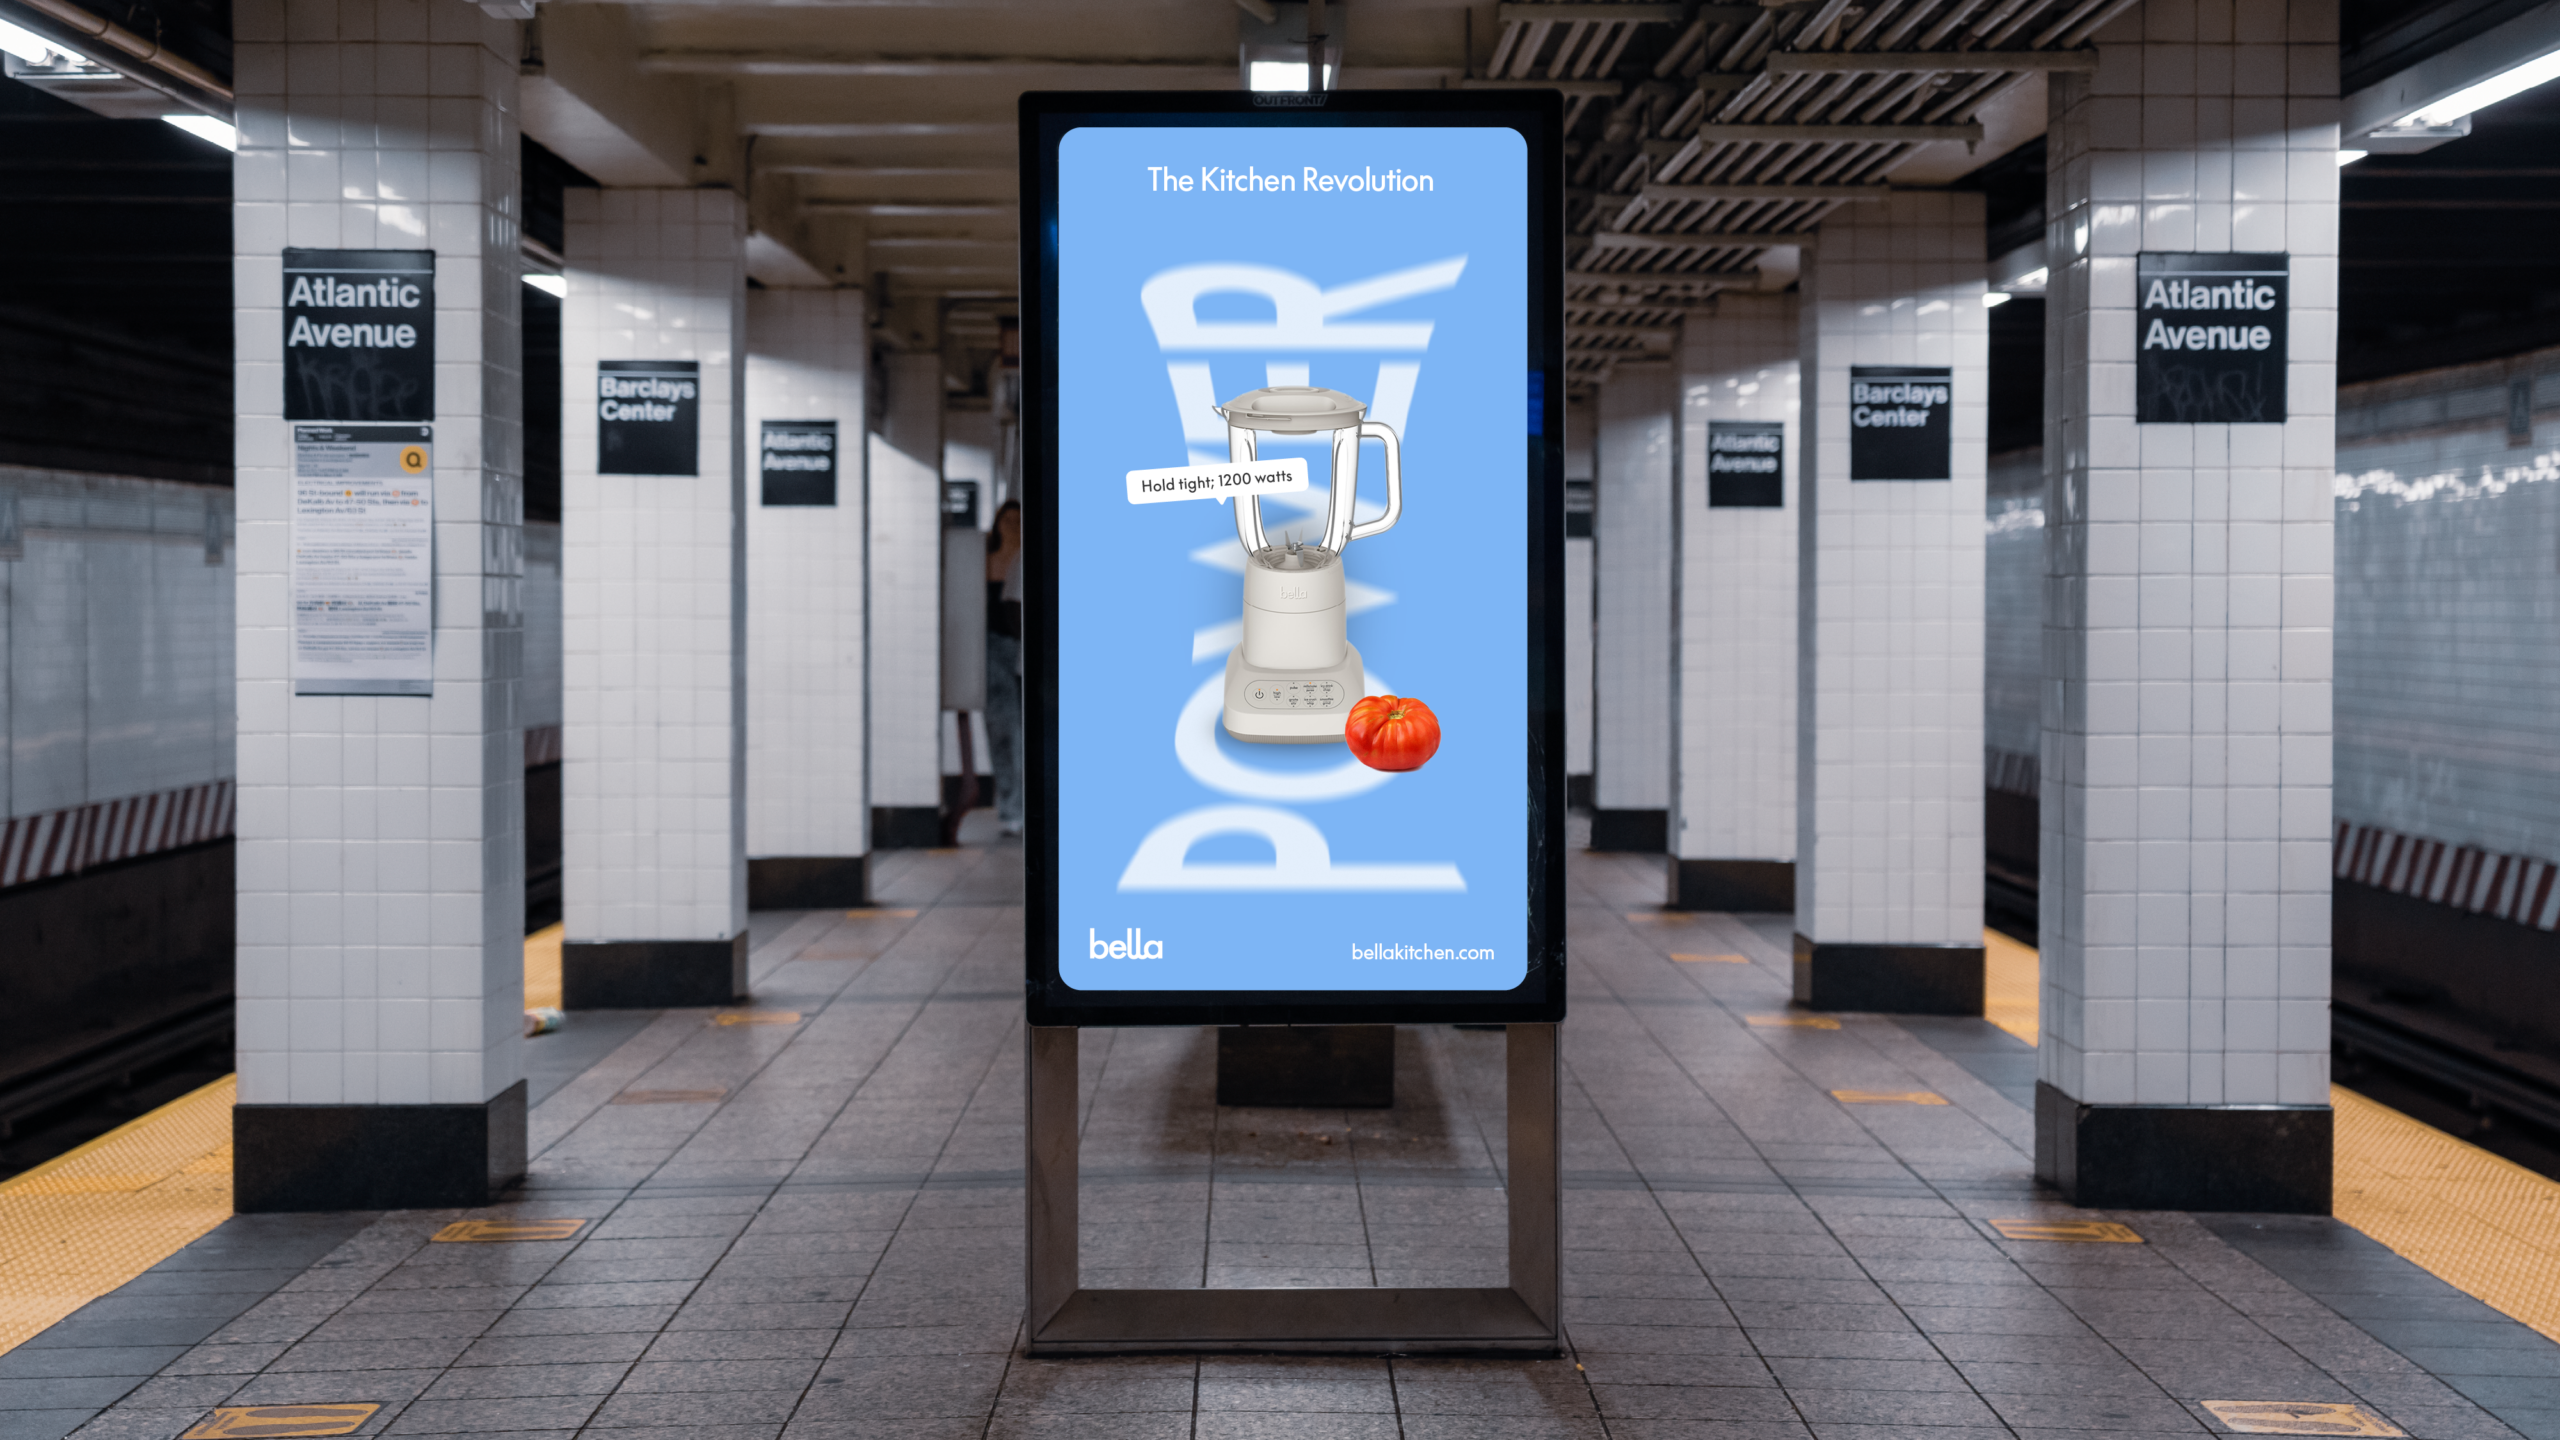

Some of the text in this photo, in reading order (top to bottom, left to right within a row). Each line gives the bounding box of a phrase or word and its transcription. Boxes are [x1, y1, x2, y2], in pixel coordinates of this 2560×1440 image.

[1147, 165, 1434, 192] The Kitchen Revolution
[288, 275, 420, 308] Atlantic
[2144, 277, 2276, 311] Atlantic
[288, 315, 416, 348] Avenue
[2144, 317, 2271, 351] Avenue
[600, 376, 696, 402] Barclays
[1853, 383, 1948, 408] Barclays
[600, 399, 677, 421] Center
[1853, 406, 1930, 427] Center
[763, 431, 832, 451] Atlantic
[1711, 432, 1780, 453] Atlantic
[406, 451, 422, 468] Q
[763, 452, 831, 471] Avenue
[1711, 453, 1778, 474] Avenue
[1142, 470, 1293, 494] Hold tight; 1200 watts
[1280, 586, 1308, 600] bella
[1089, 927, 1163, 960] bella
[1352, 942, 1495, 960] bellakitchen.com
